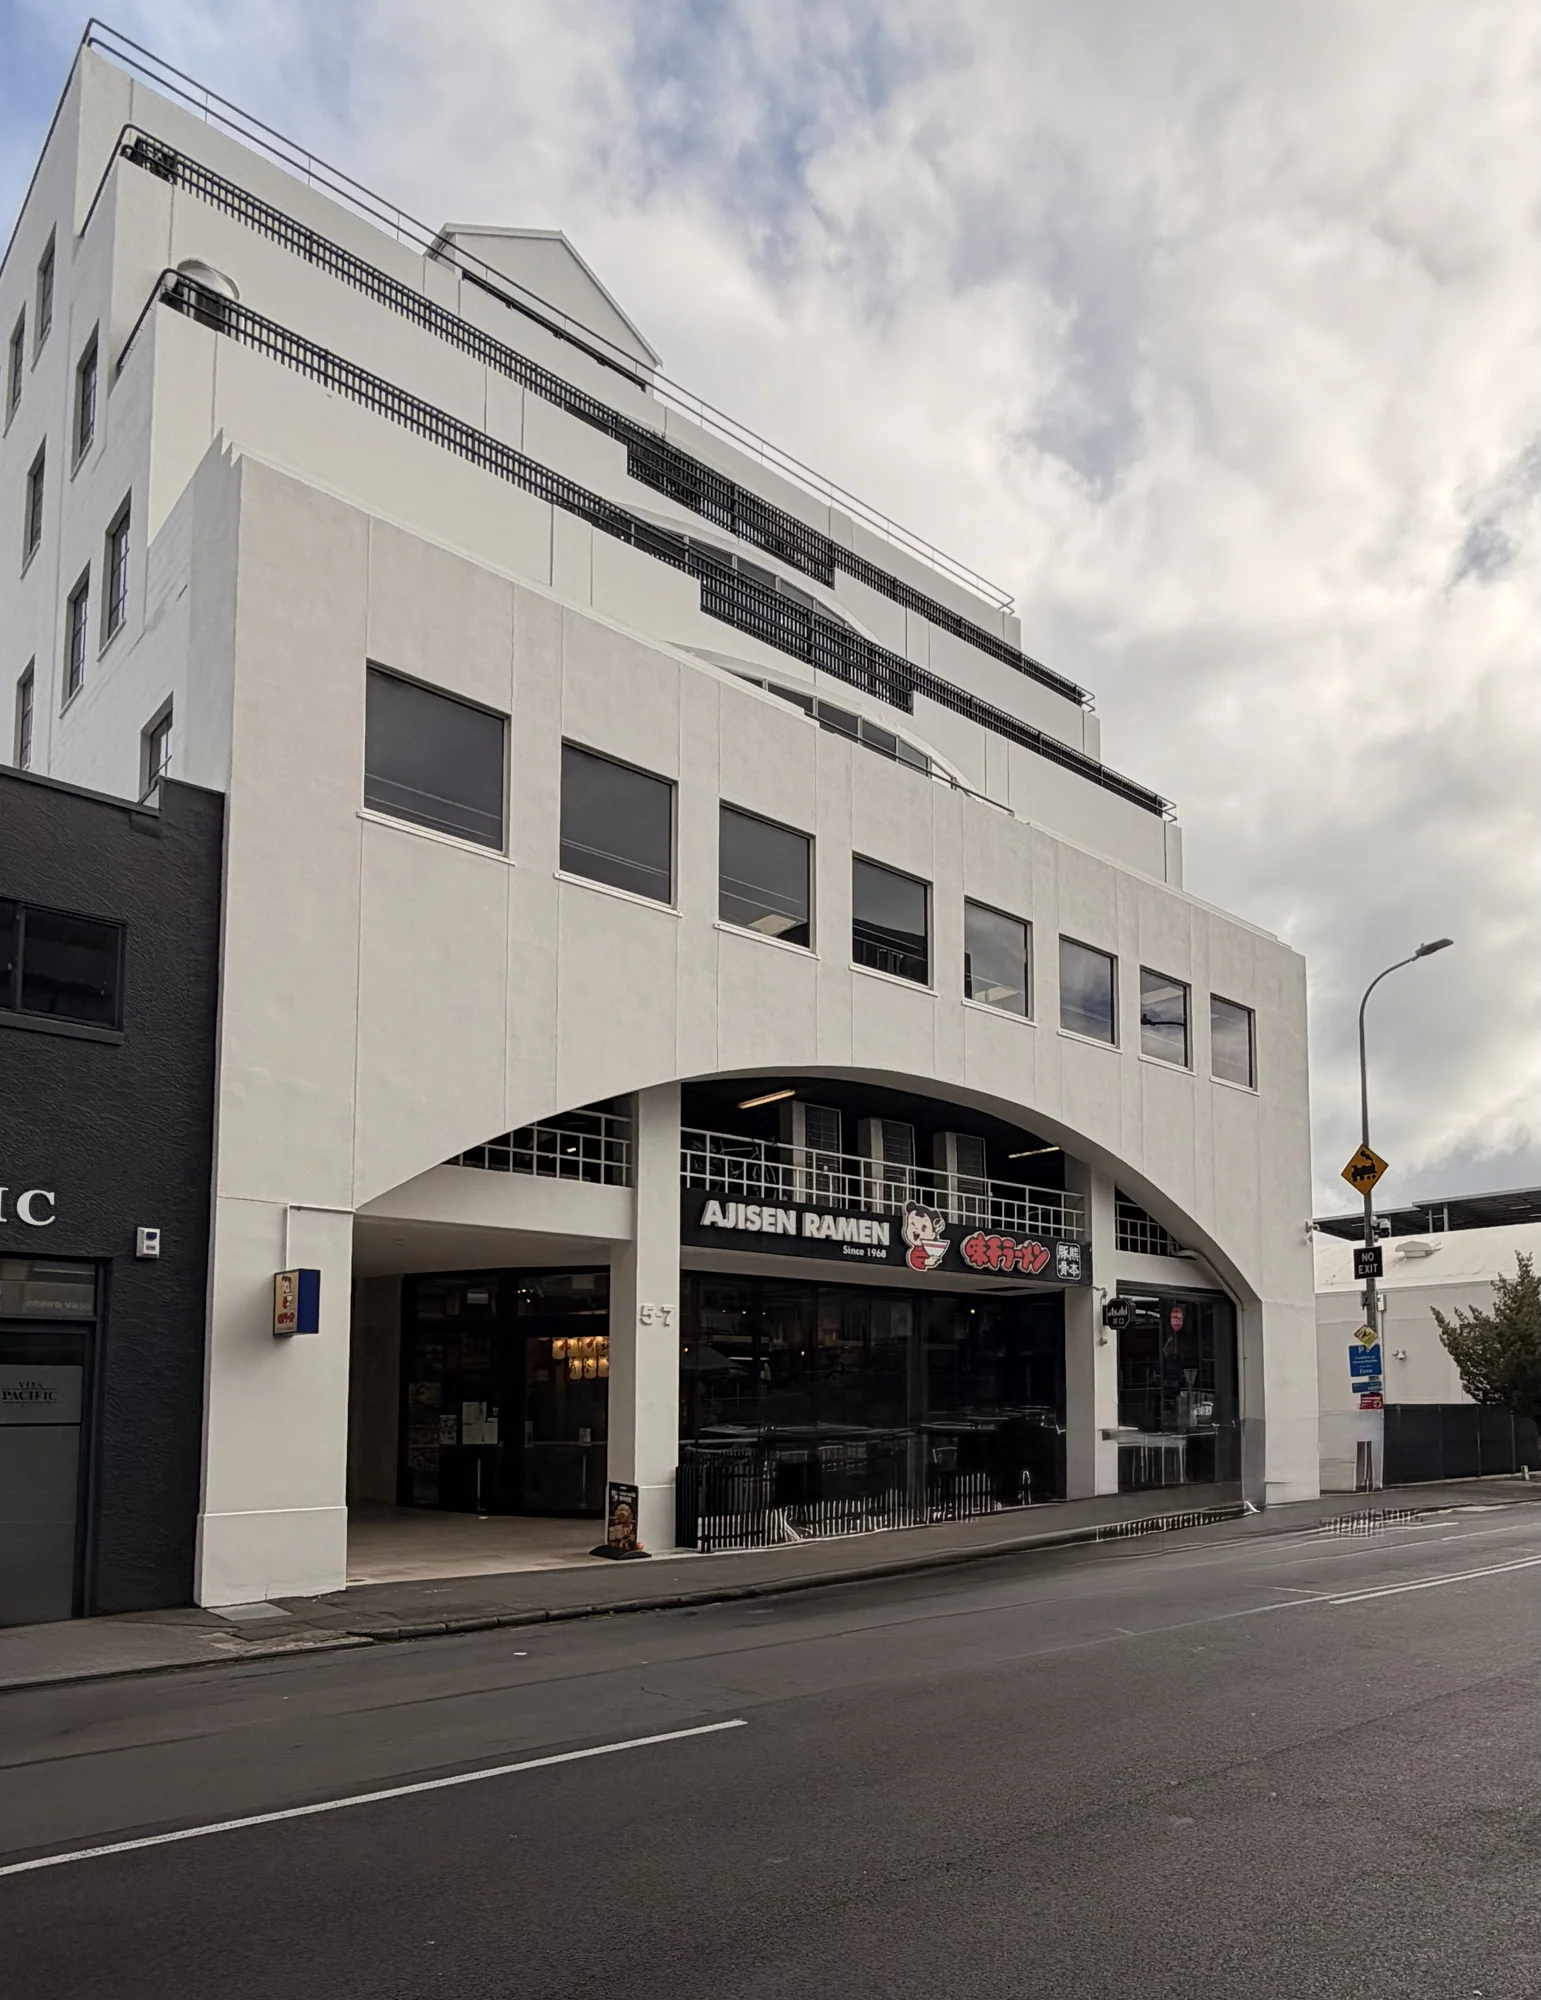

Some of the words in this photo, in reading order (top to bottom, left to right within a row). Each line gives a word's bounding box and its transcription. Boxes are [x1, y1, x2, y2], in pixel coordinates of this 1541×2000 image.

[700, 1199, 797, 1236] AJISEN
[802, 1211, 891, 1246] RAMEN
[842, 1244, 865, 1256] Since
[867, 1246, 887, 1258] 1968
[1361, 1252, 1375, 1262] NO
[1358, 1263, 1378, 1274] EXIT
[639, 1303, 676, 1327] 5-7
